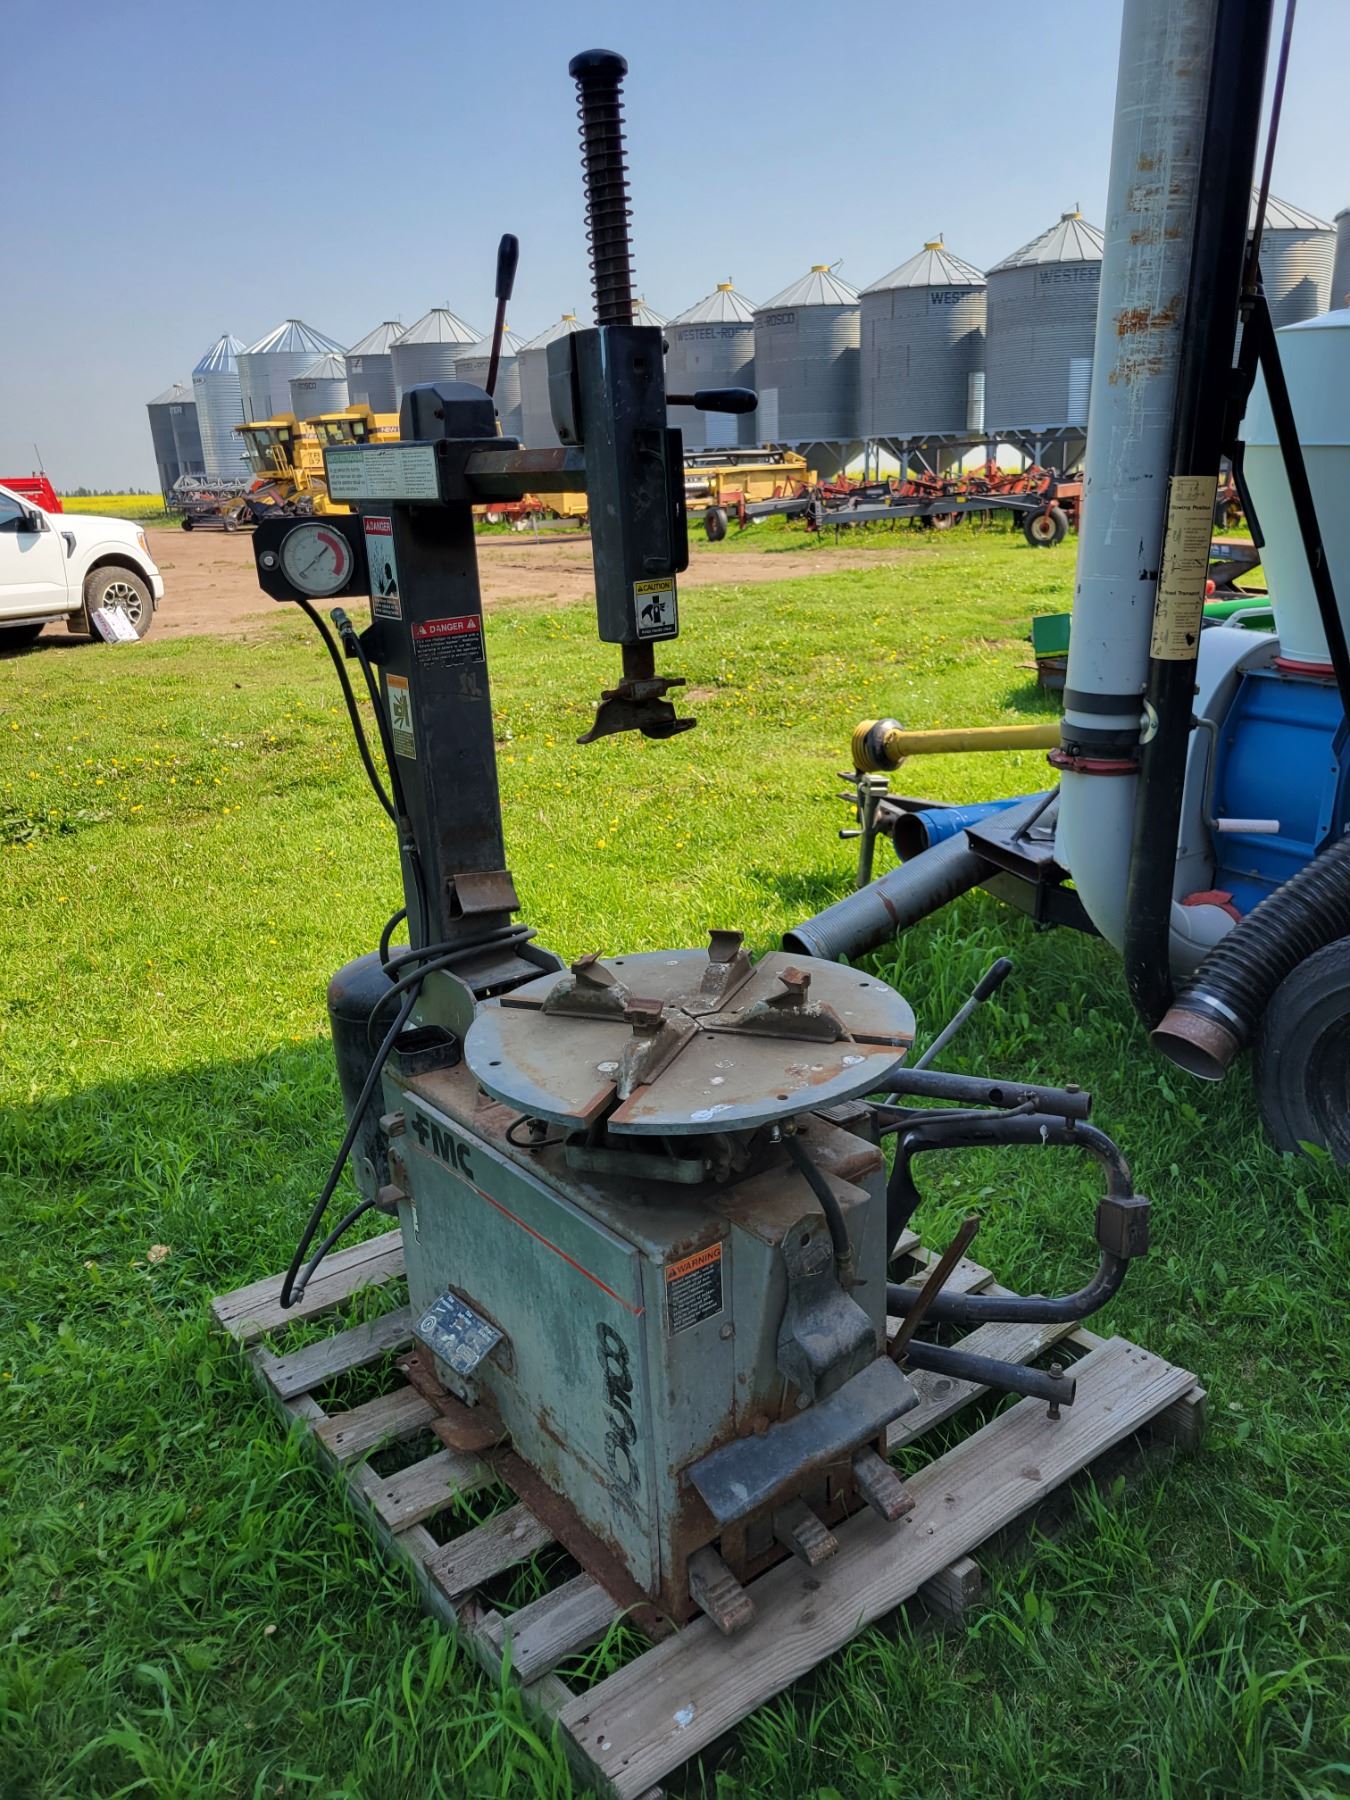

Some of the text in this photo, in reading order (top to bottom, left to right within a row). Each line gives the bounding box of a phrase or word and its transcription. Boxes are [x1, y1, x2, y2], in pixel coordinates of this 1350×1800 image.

[369, 521, 391, 532] DANGER
[644, 582, 670, 591] CAUTION
[429, 621, 464, 633] DANGER
[411, 1111, 475, 1181] FMC
[677, 1248, 721, 1272] WARNING
